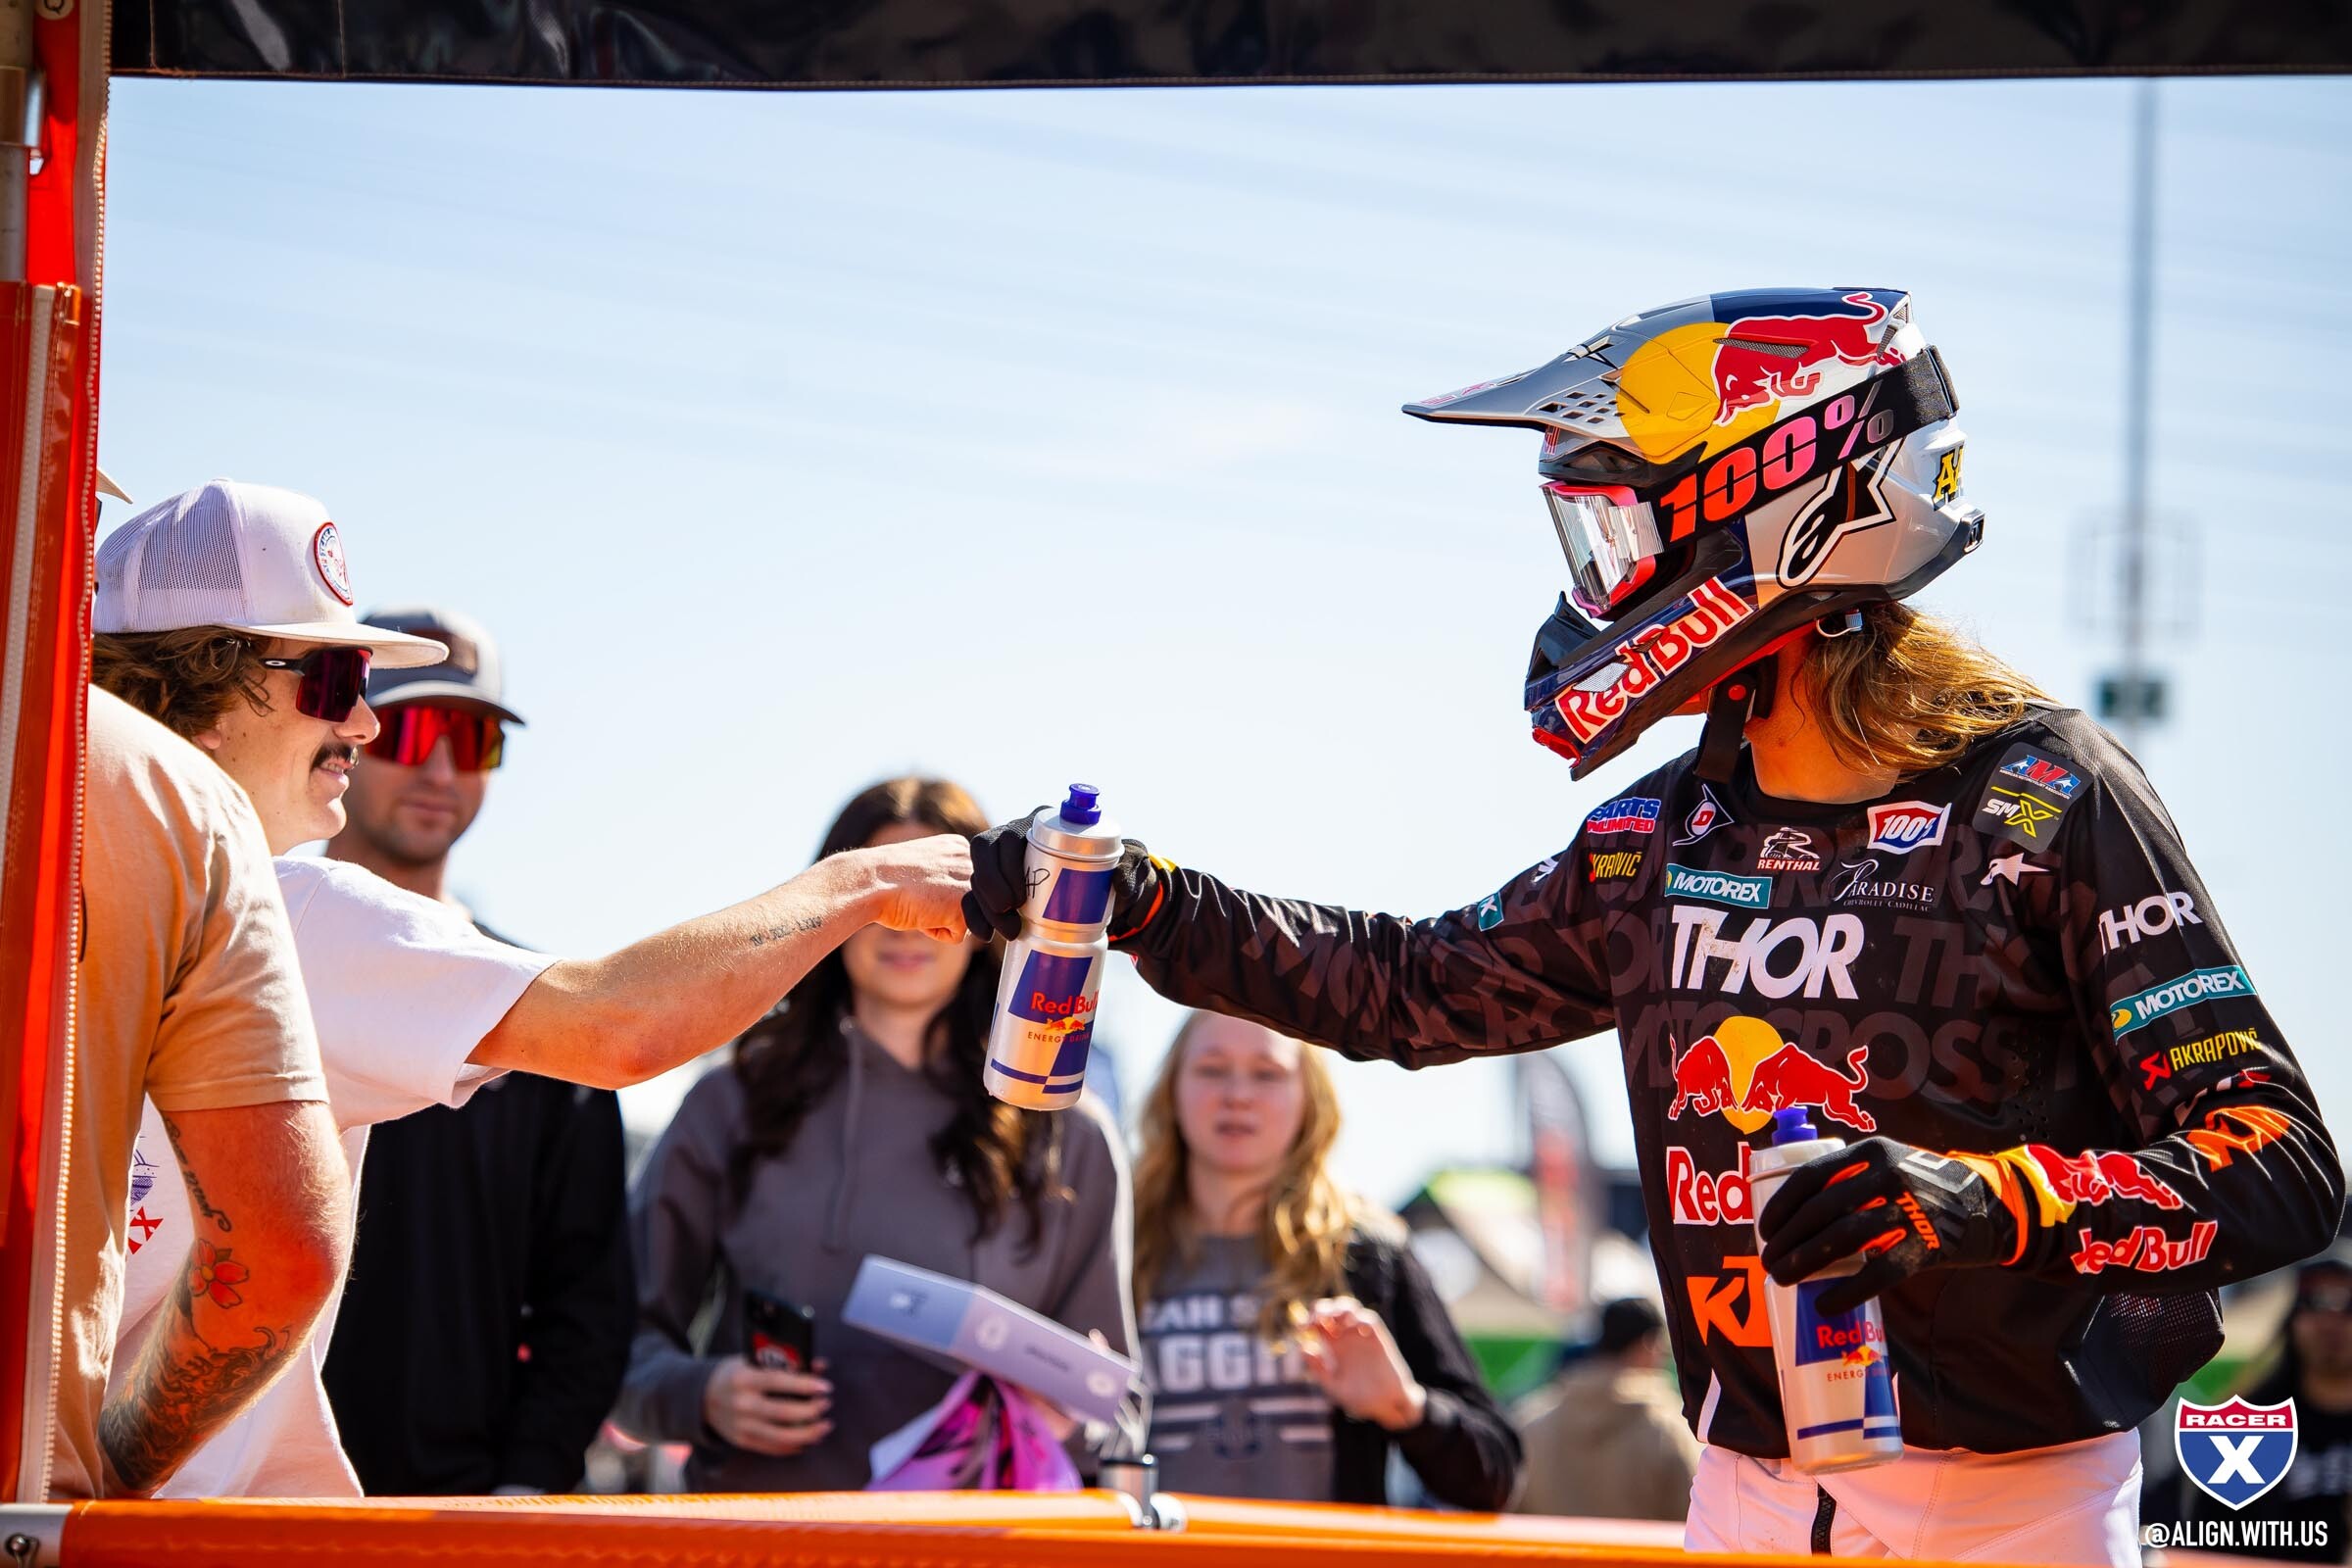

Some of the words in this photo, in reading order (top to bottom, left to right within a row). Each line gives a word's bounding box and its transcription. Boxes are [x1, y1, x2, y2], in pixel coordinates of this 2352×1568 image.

[1660, 379, 1894, 543] 100%
[2000, 754, 2082, 797] AMA
[1673, 871, 1762, 904] MOTOREX
[1756, 858, 1821, 871] RENTHAL
[1671, 904, 1865, 1001] THOR
[2133, 970, 2246, 1020] MOTOREX
[1895, 1191, 1940, 1251] THOR
